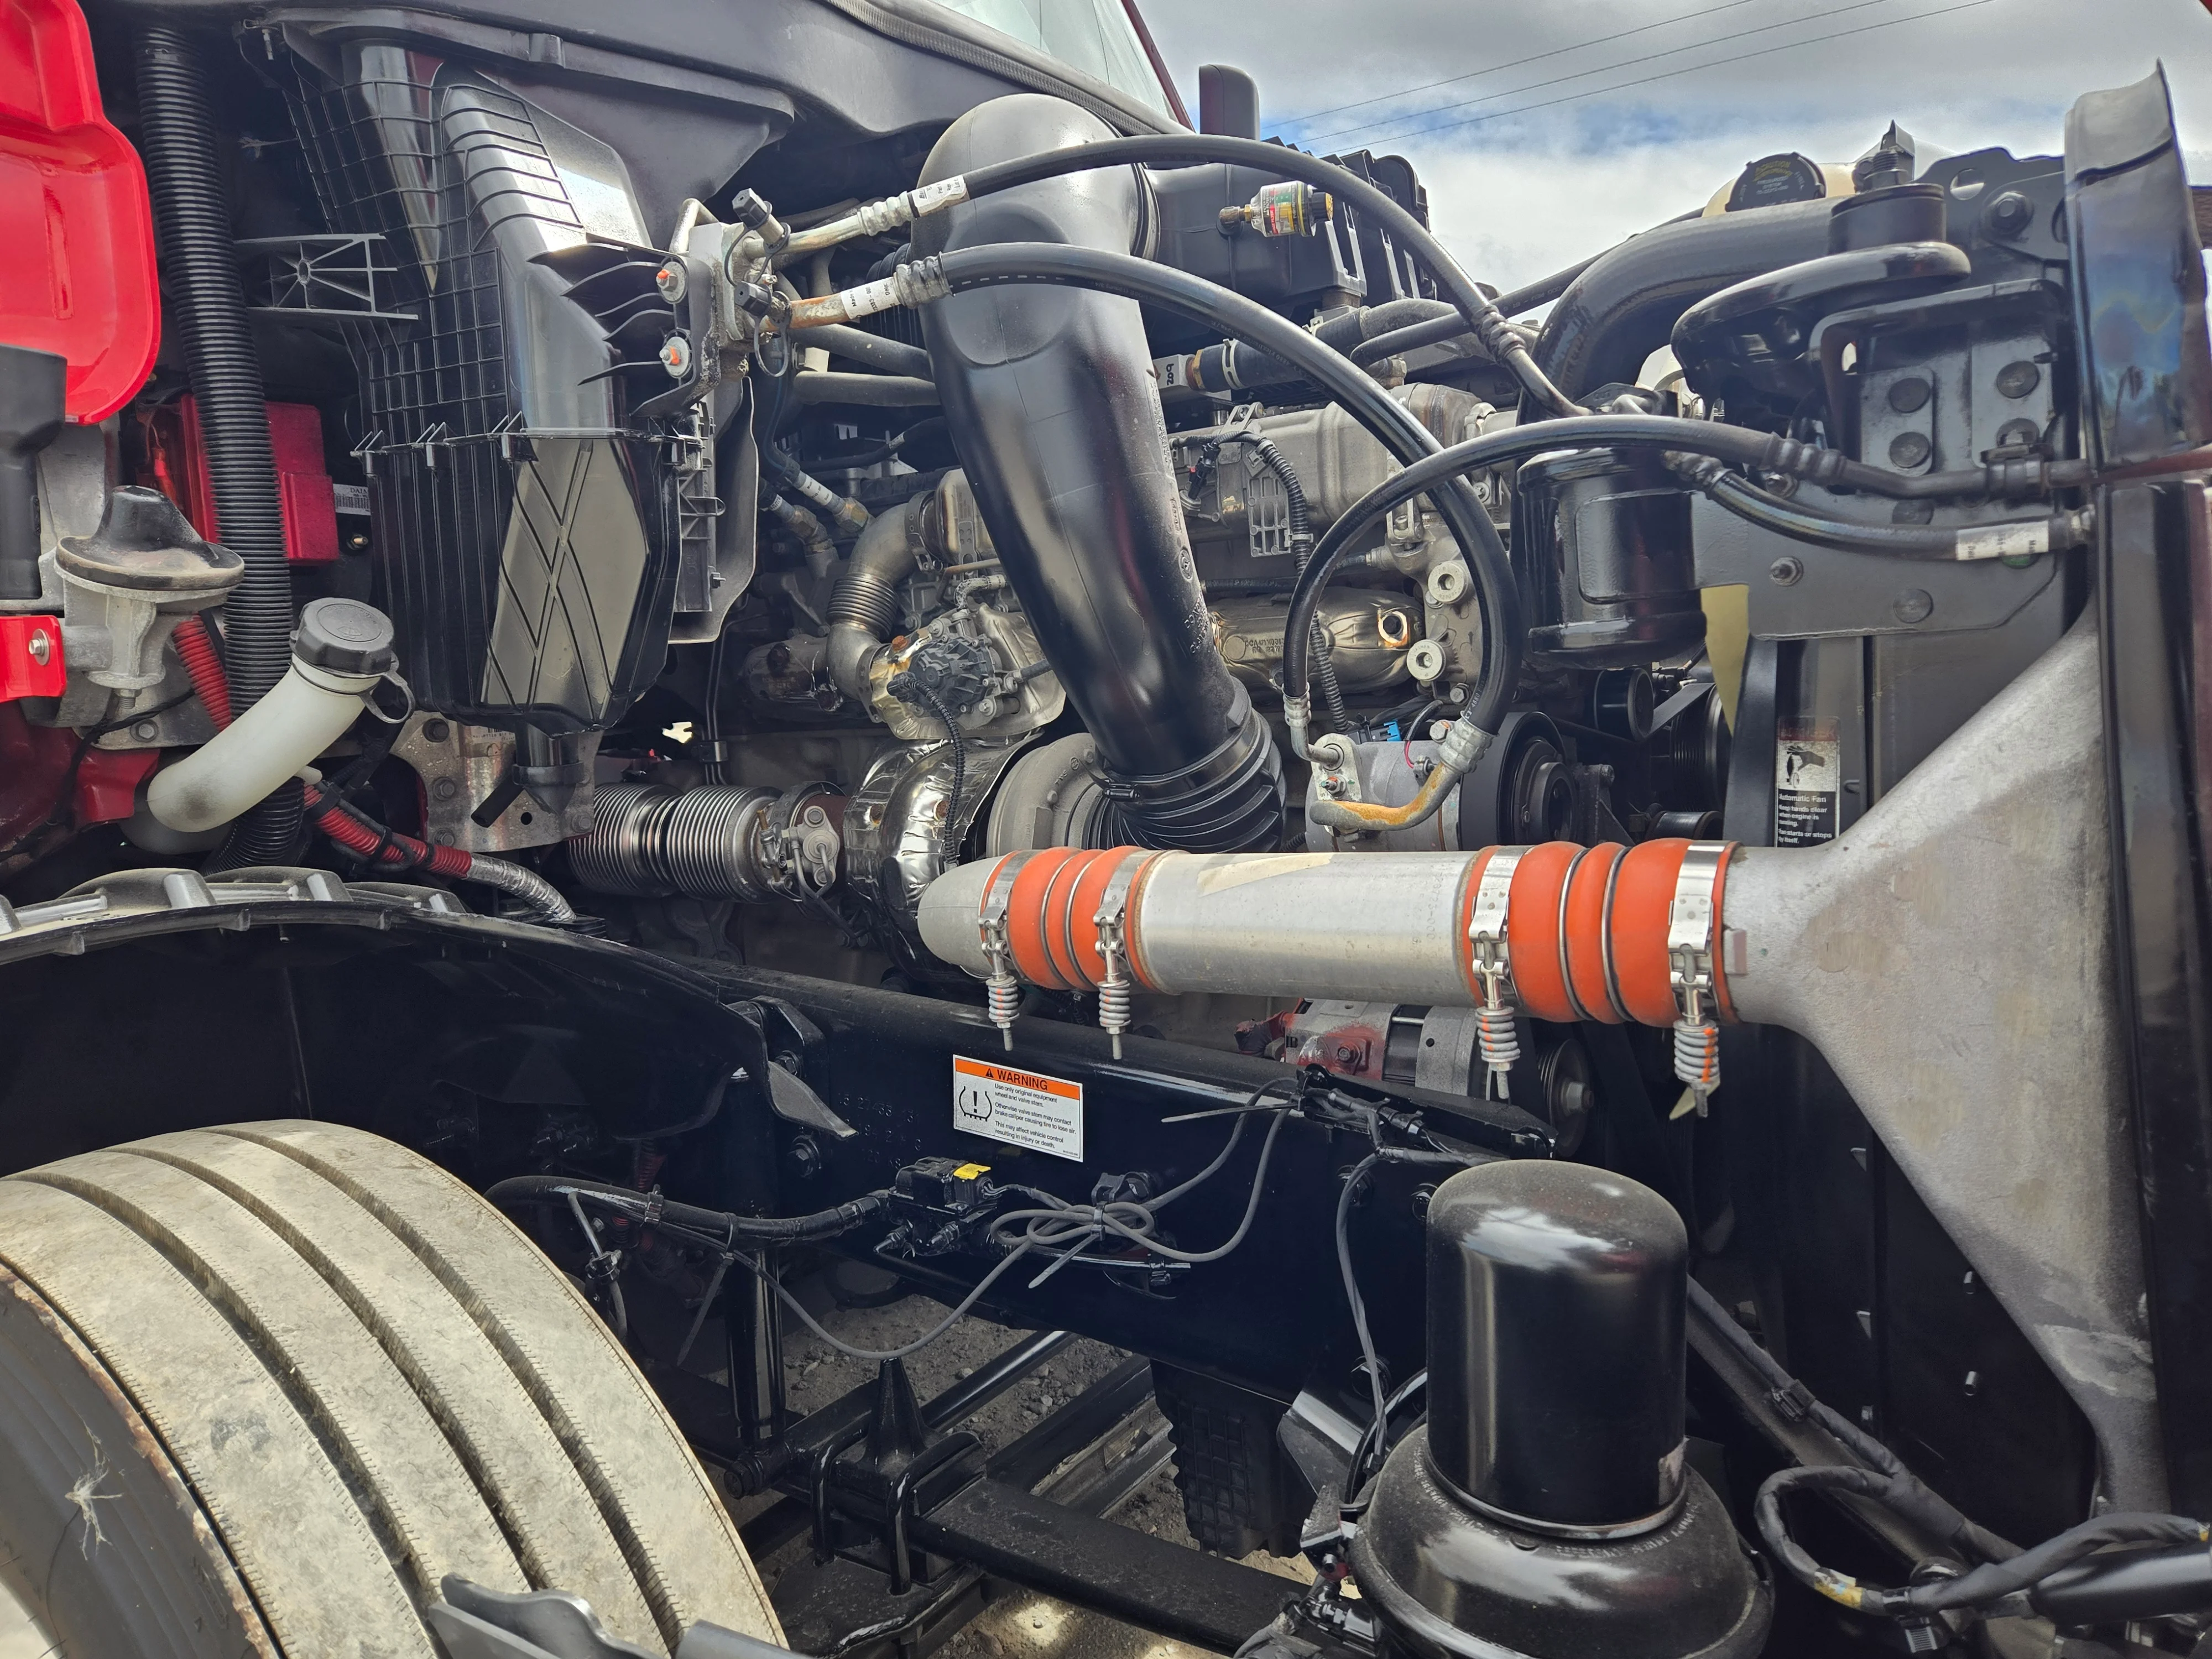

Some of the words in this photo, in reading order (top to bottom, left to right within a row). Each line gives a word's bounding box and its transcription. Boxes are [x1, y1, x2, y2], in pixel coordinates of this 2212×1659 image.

[997, 1069, 1047, 1091] WARNING
[1015, 1088, 1032, 1097] original
[1032, 1093, 1057, 1103] equipment
[995, 1102, 1018, 1112] Otherwise
[1024, 1117, 1042, 1126] causing
[995, 1129, 1015, 1139] resulting
[1021, 1134, 1034, 1144] injury
[1041, 1140, 1055, 1149] death.
[1030, 1130, 1046, 1138] vehicle
[1047, 1135, 1063, 1143] control
